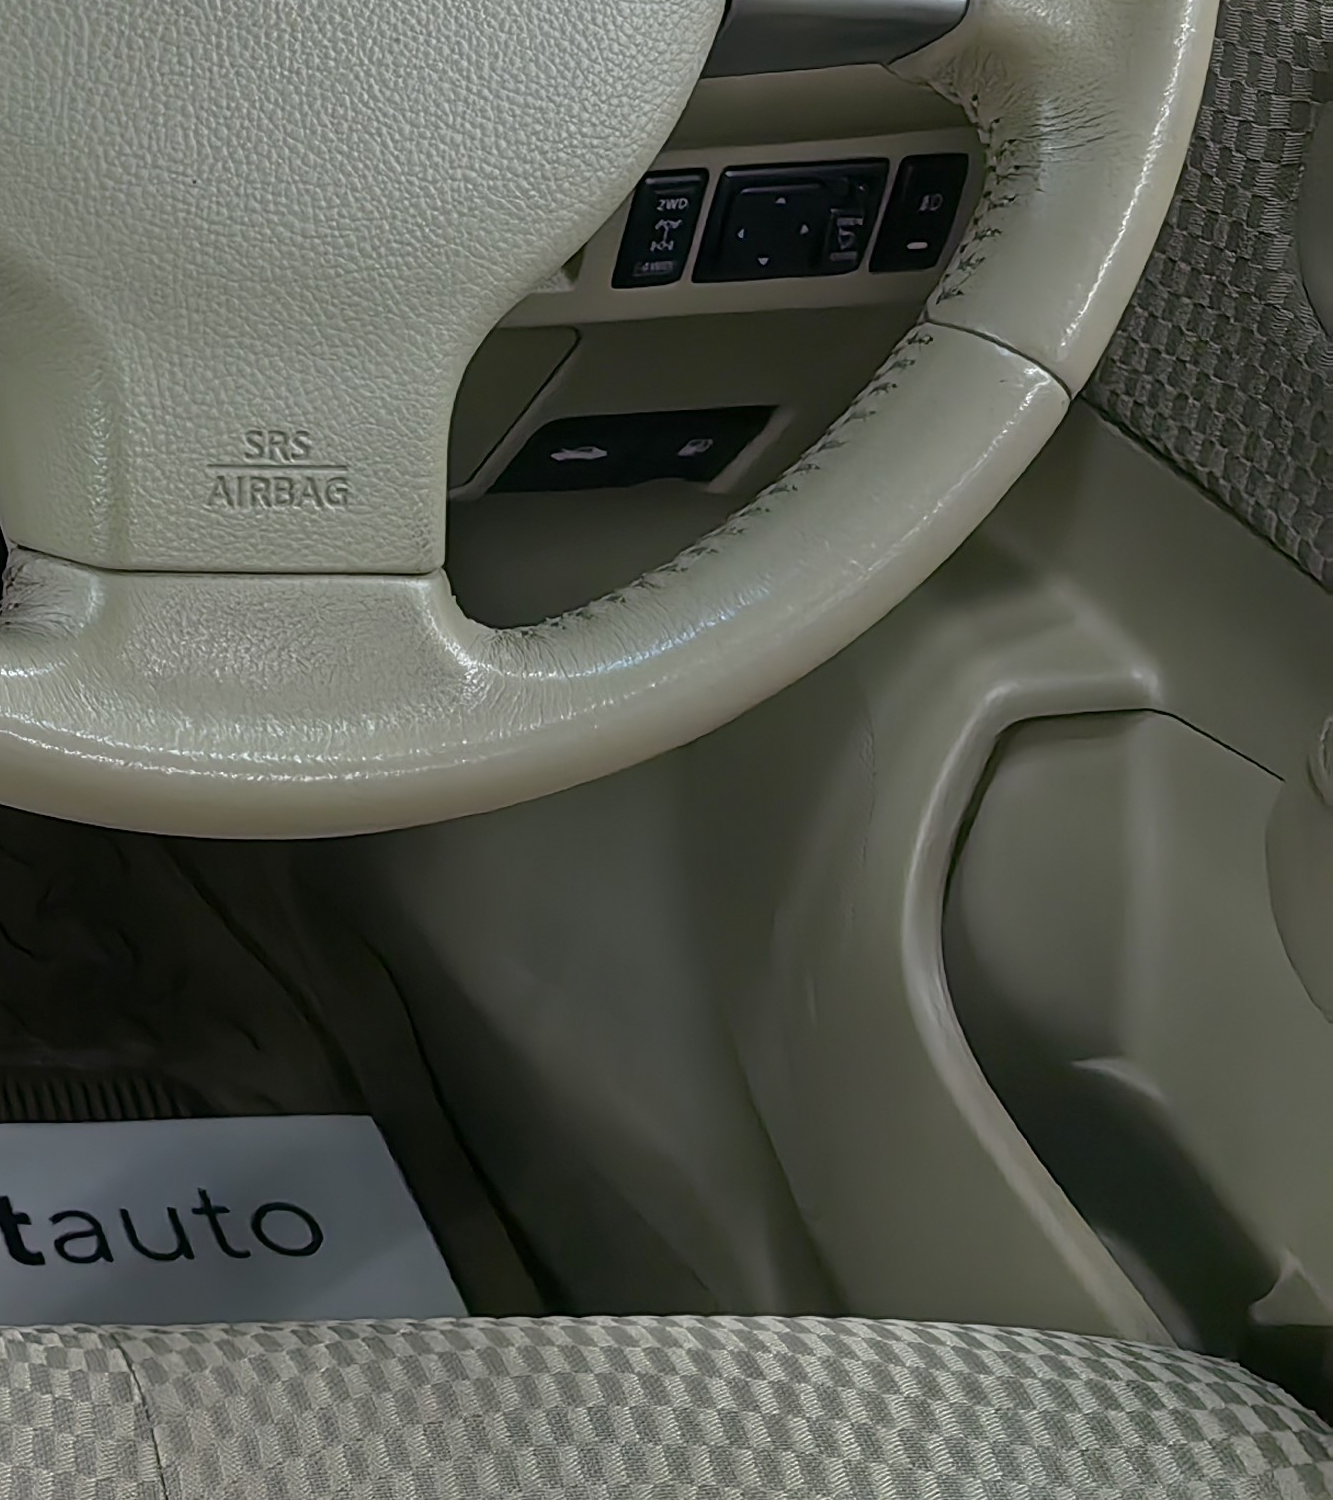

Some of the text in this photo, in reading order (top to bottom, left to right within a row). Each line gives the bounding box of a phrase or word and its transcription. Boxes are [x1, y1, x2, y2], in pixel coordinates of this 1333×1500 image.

[656, 197, 689, 212] 2WD
[242, 429, 312, 463] SRS
[204, 473, 350, 510] AIRBAG
